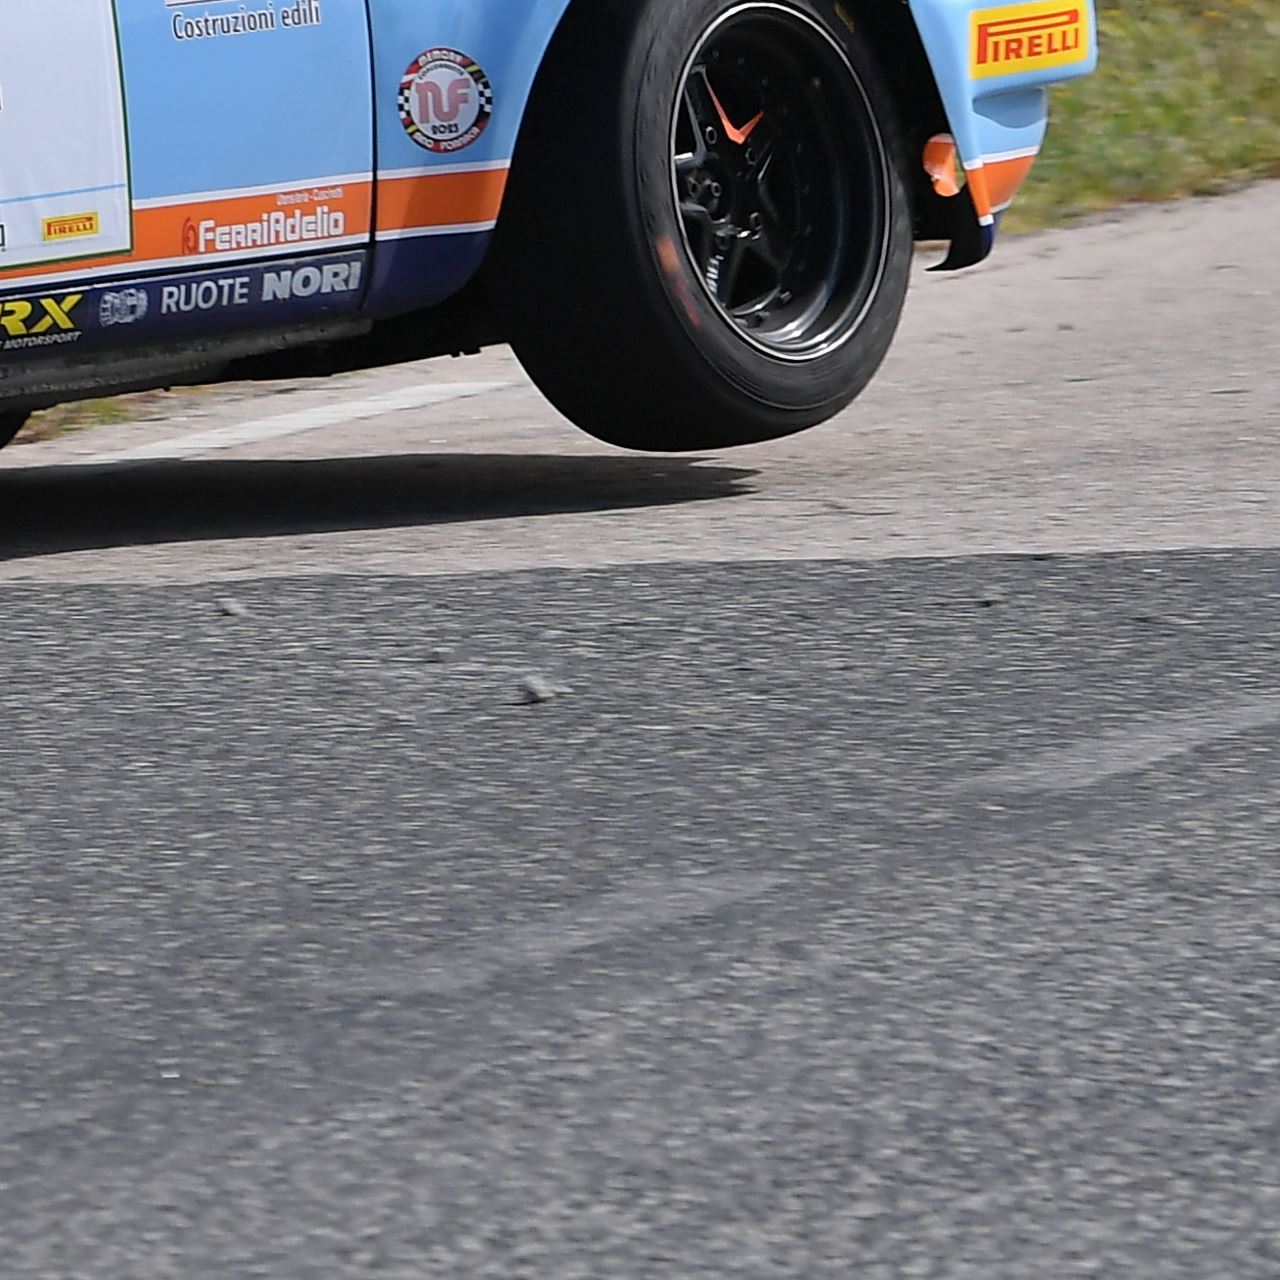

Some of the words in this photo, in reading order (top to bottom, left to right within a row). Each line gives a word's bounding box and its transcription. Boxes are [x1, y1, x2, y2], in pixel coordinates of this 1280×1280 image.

[172, 5, 276, 40] Costruzioni
[281, 0, 321, 27] edili
[976, 9, 1079, 65] PIRELLI
[46, 216, 94, 236] PIRELLI
[160, 276, 249, 314] RUOTE
[262, 262, 363, 302] NORI
[3, 331, 83, 351] MOTORSPORT
